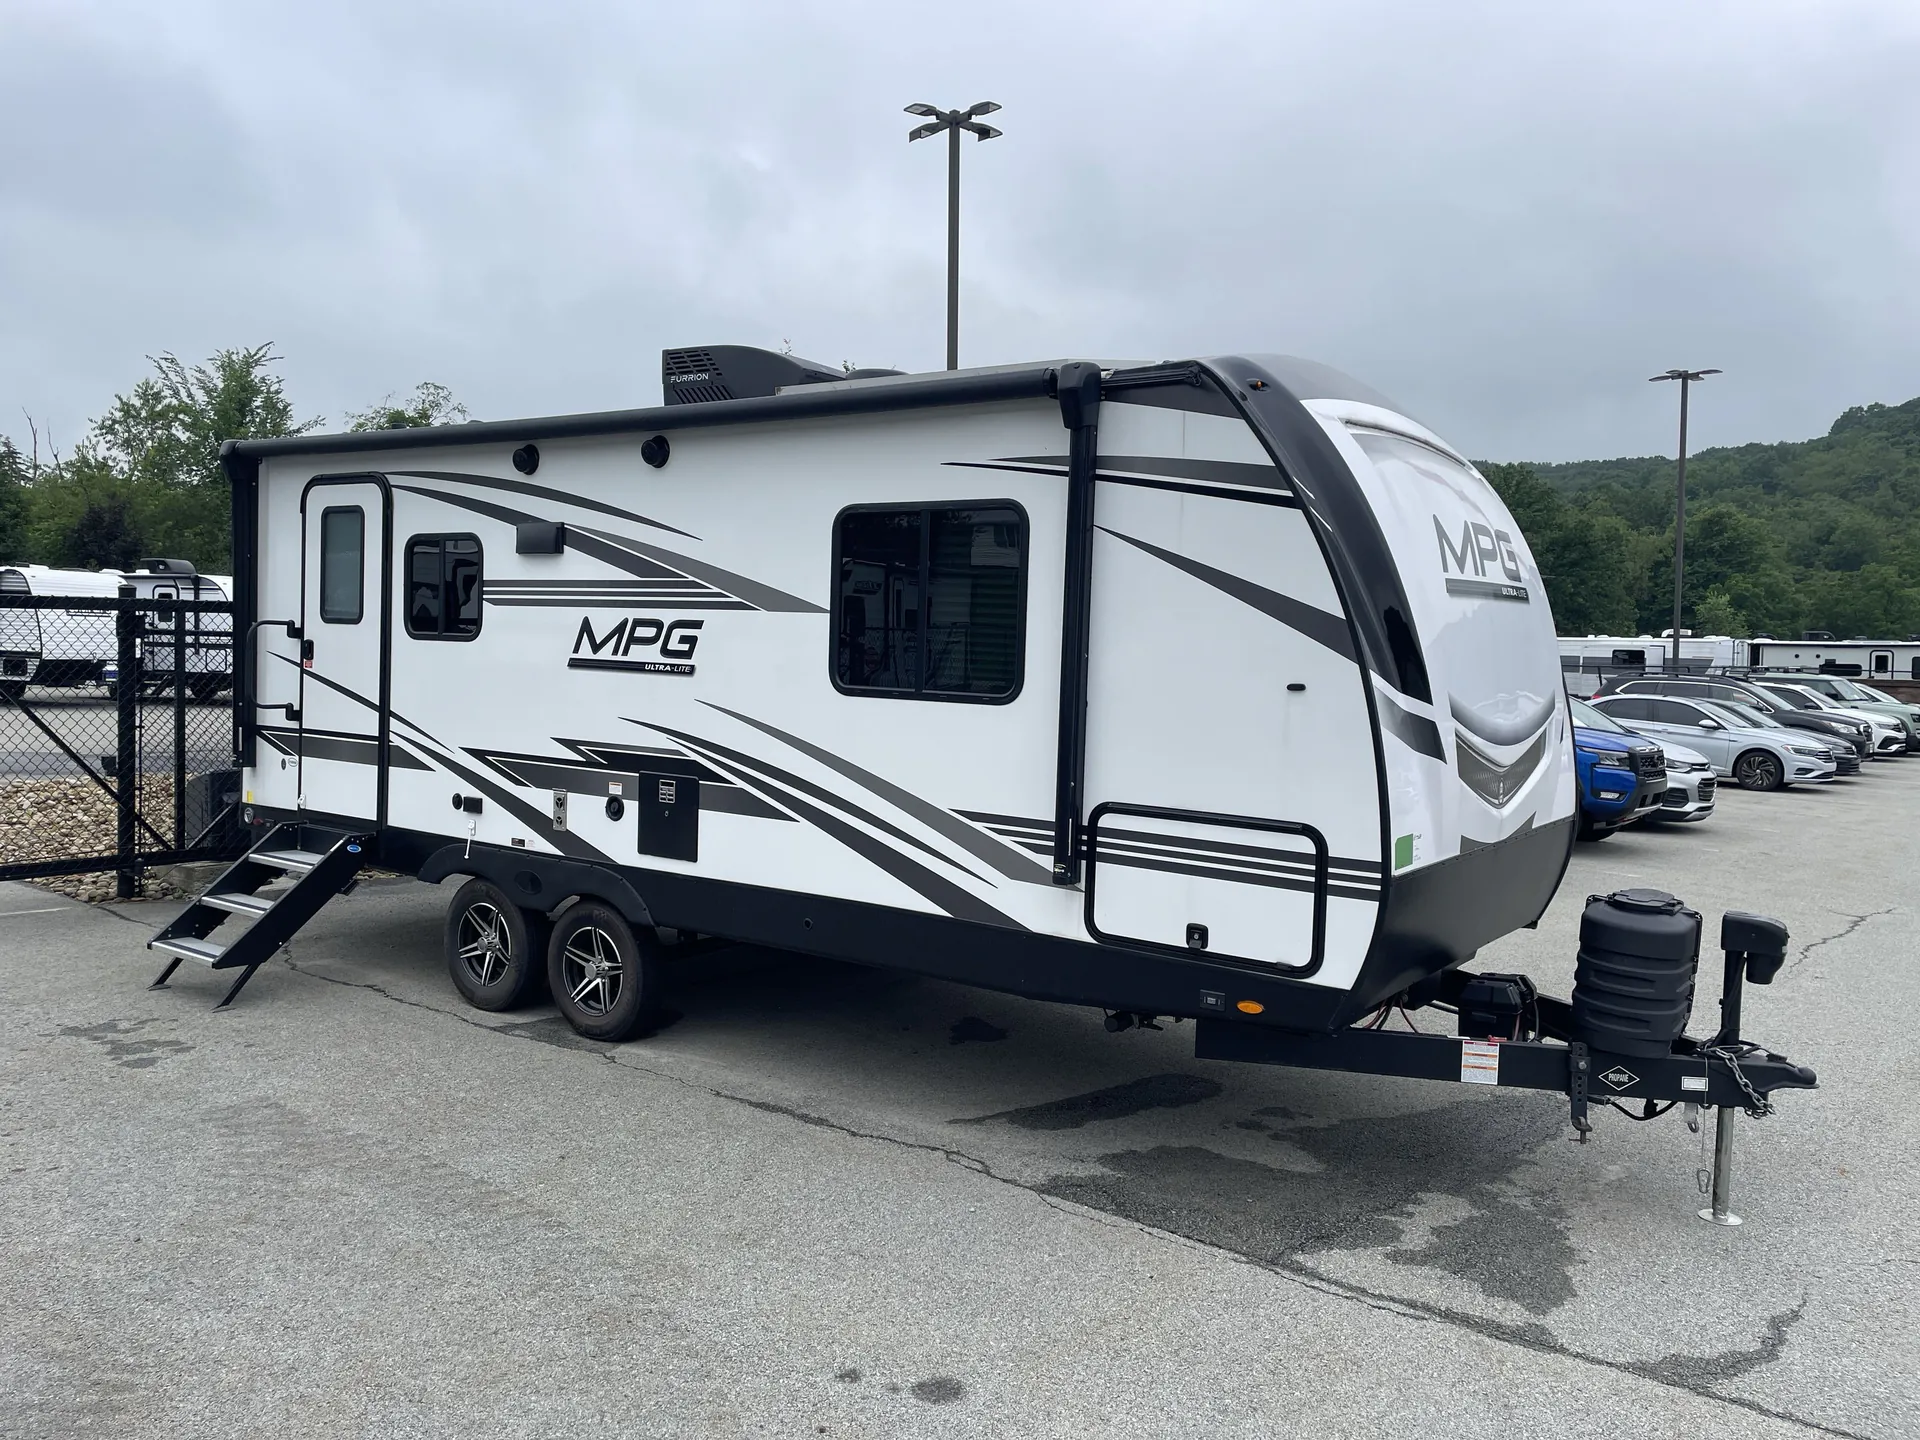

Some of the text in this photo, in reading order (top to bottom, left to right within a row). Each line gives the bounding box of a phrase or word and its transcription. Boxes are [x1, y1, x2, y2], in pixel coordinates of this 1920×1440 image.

[670, 373, 709, 383] FURRION
[1432, 513, 1522, 583] MPG
[1501, 586, 1527, 598] ULTRA-LITE
[572, 615, 704, 660] MPG
[644, 663, 692, 673] ULTRA-LITE
[1608, 1073, 1629, 1083] PROPANE
